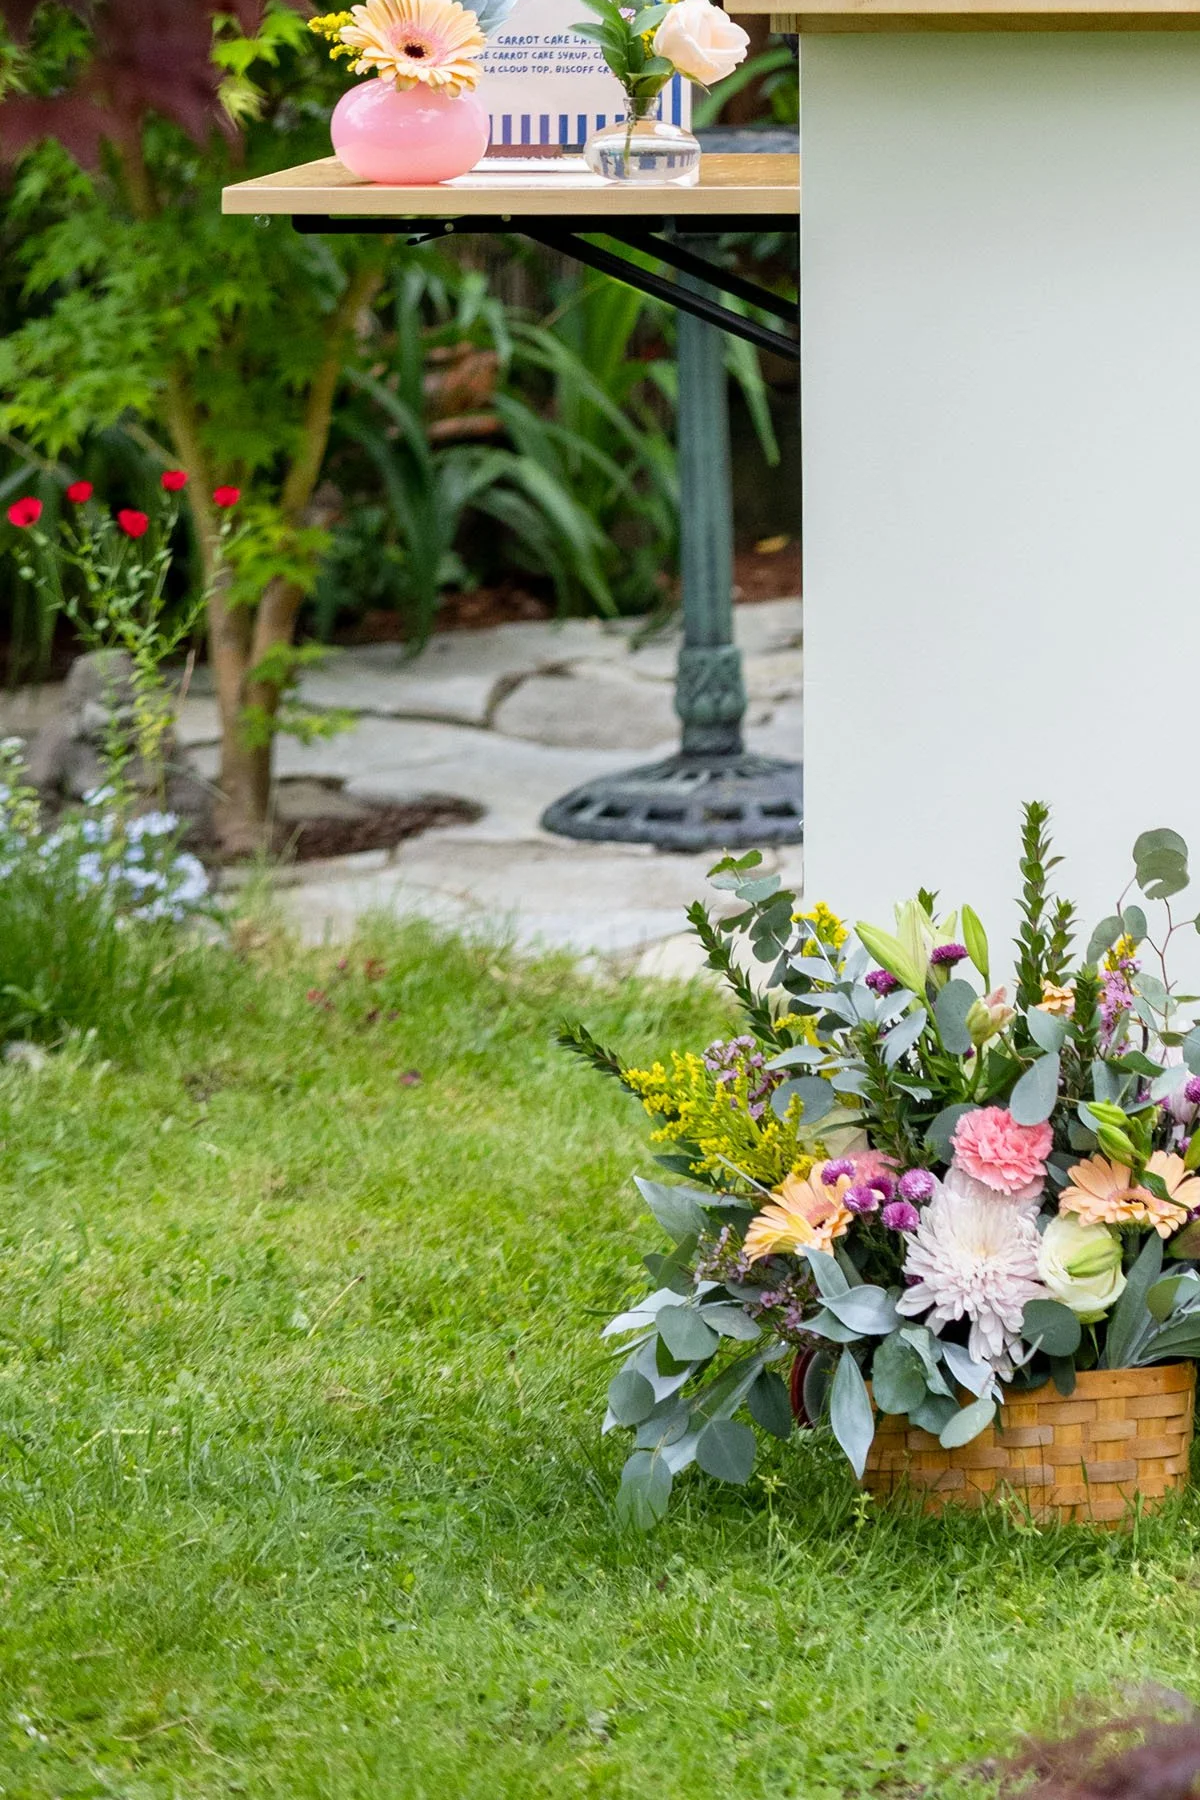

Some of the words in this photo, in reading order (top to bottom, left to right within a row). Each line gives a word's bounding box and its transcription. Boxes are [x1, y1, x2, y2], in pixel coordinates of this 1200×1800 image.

[497, 35, 539, 45] CARROT
[543, 35, 570, 45] CAKE
[492, 51, 528, 60] CARROT
[531, 51, 554, 60] CAKE
[498, 65, 528, 73] CLOUD
[555, 65, 595, 74] BISCOFF
